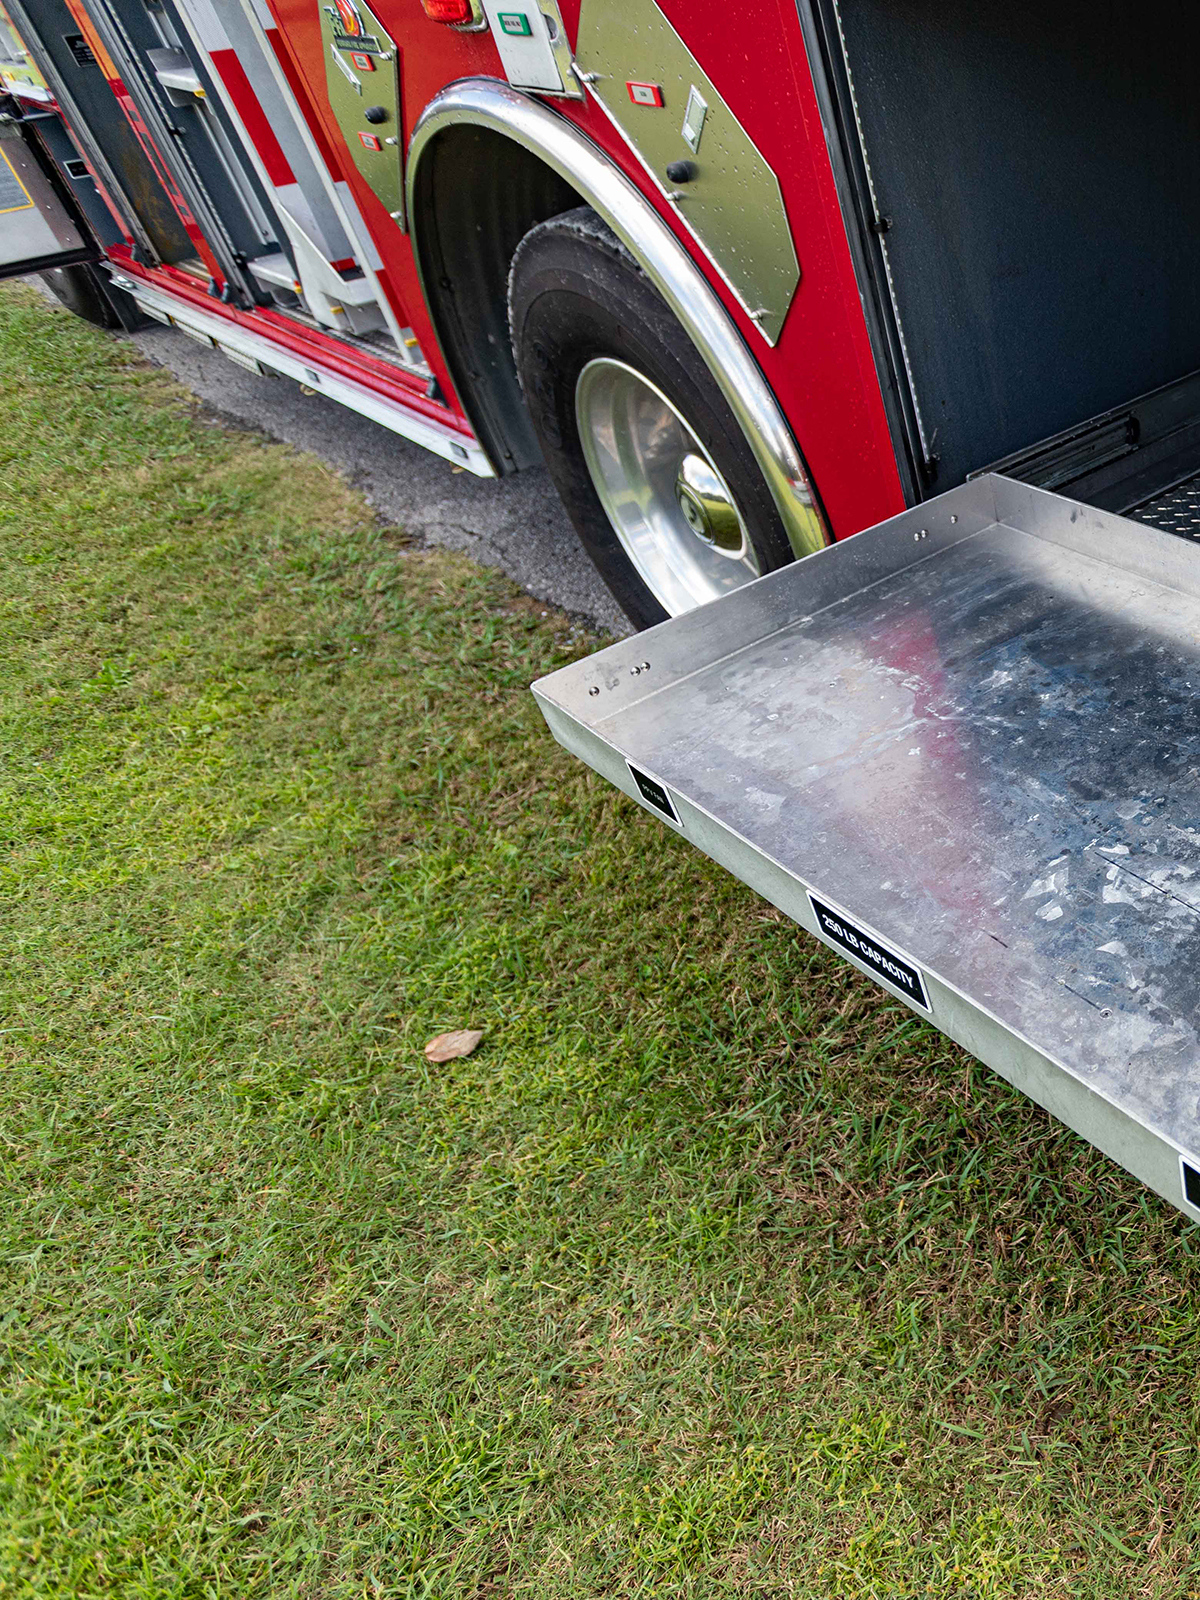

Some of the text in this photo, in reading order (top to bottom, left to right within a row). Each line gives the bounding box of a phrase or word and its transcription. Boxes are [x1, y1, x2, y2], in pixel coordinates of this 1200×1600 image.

[822, 913, 914, 988] 250 LB CAPACITY
